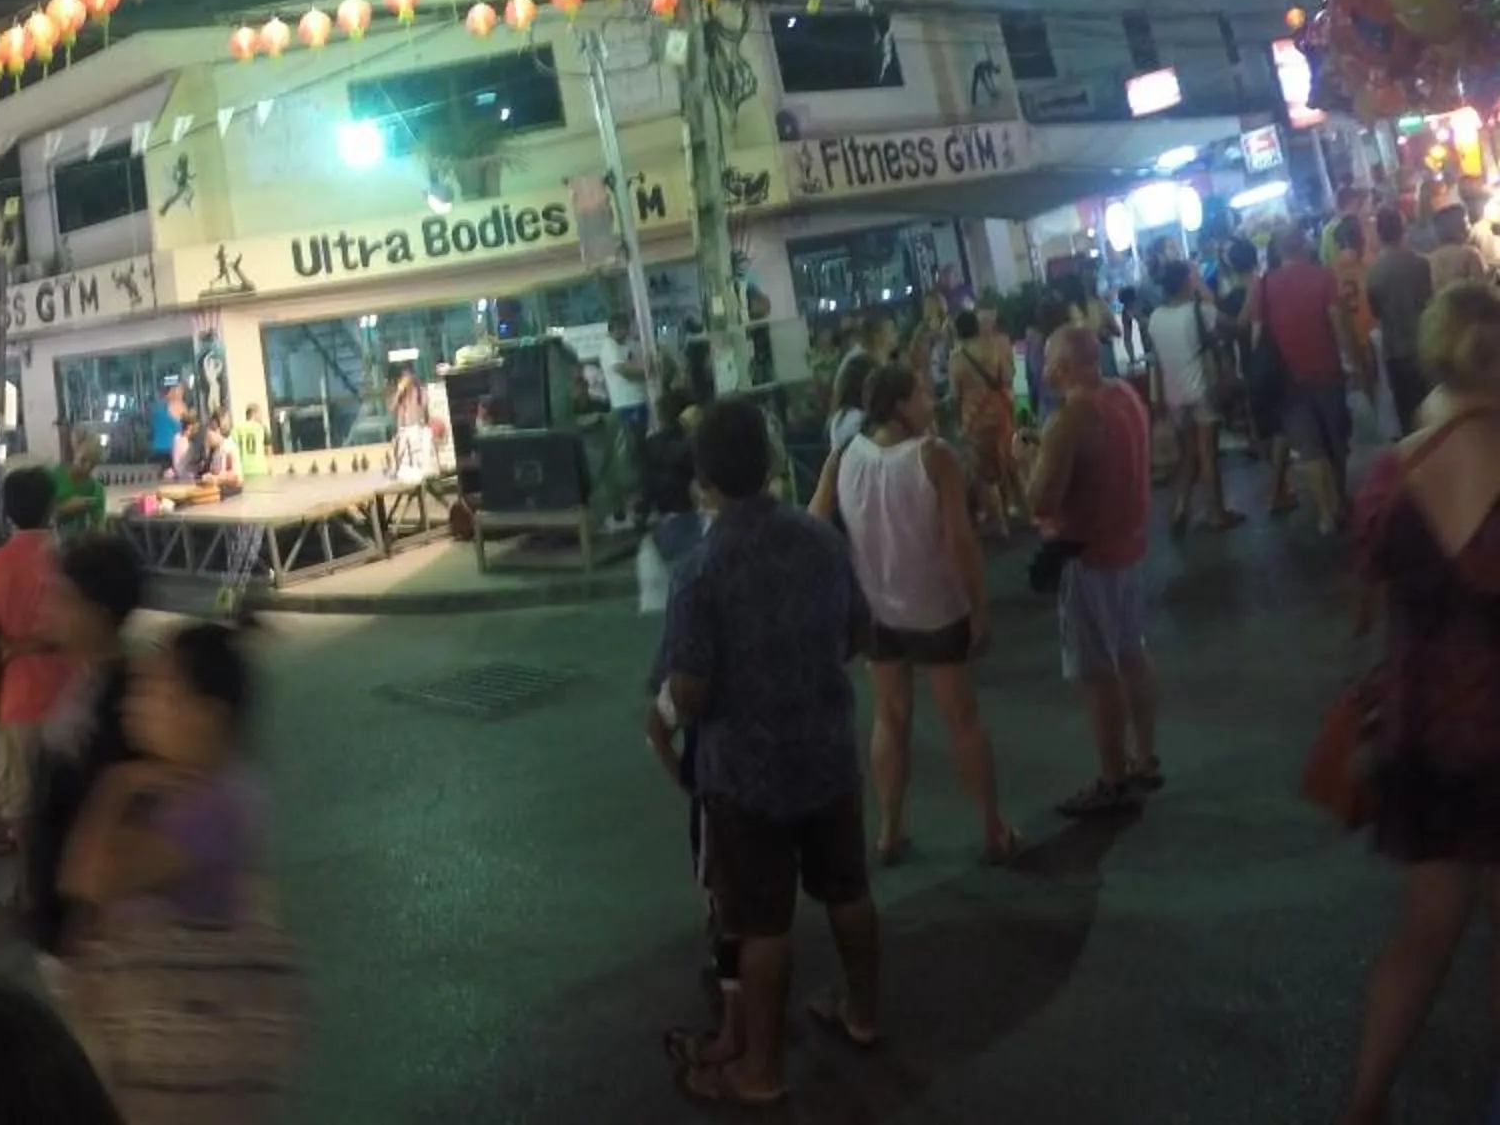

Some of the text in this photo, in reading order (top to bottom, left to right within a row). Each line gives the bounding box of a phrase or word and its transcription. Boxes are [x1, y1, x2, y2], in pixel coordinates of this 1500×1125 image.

[819, 125, 998, 189] Fitness GYM
[291, 201, 569, 277] Ultra Bodies
[36, 273, 99, 324] GYM
